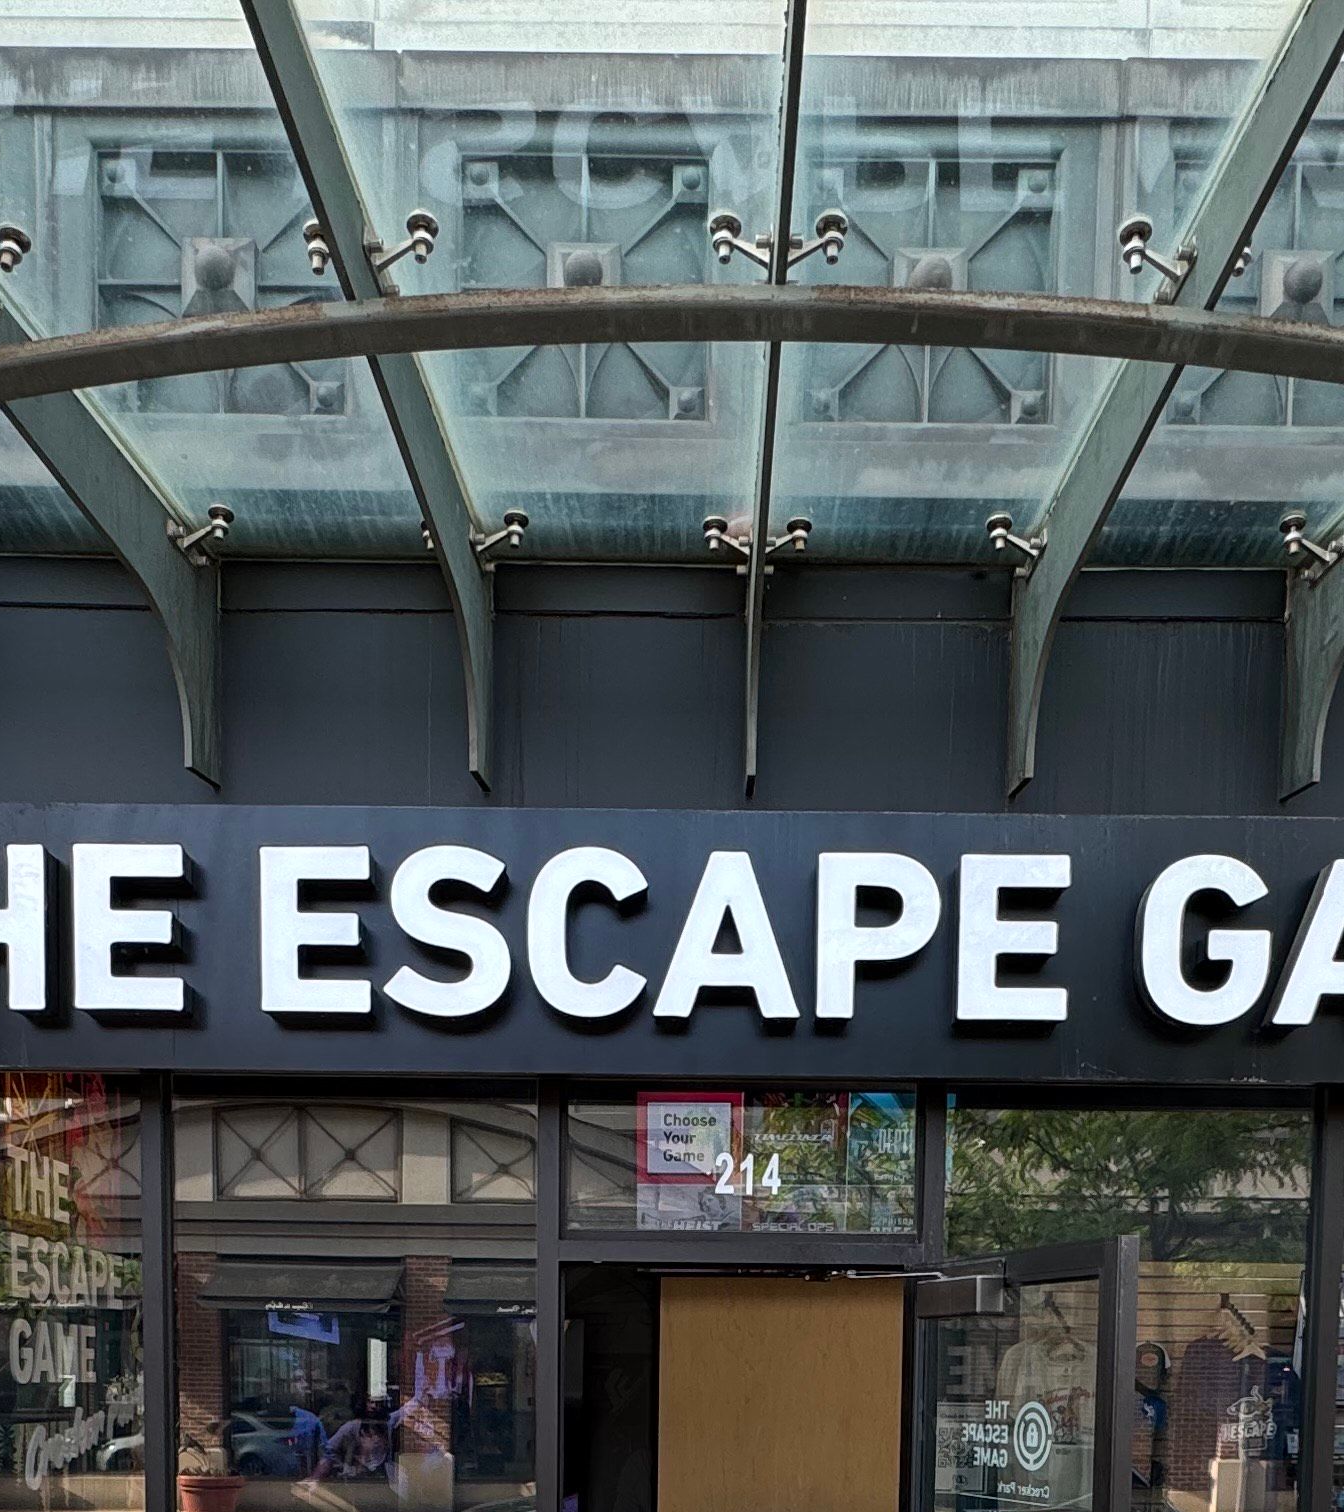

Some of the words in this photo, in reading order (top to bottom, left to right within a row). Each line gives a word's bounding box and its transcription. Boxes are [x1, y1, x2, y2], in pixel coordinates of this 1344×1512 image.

[259, 845, 1072, 1023] ESCAPE
[663, 1113, 717, 1128] Choose
[663, 1131, 696, 1146] Your
[663, 1149, 705, 1163] Game
[714, 1152, 782, 1196] 214
[4, 1143, 70, 1224] THE
[808, 1222, 835, 1232] OPS
[7, 1233, 124, 1309] ESCAPE
[8, 1318, 97, 1385] GAME
